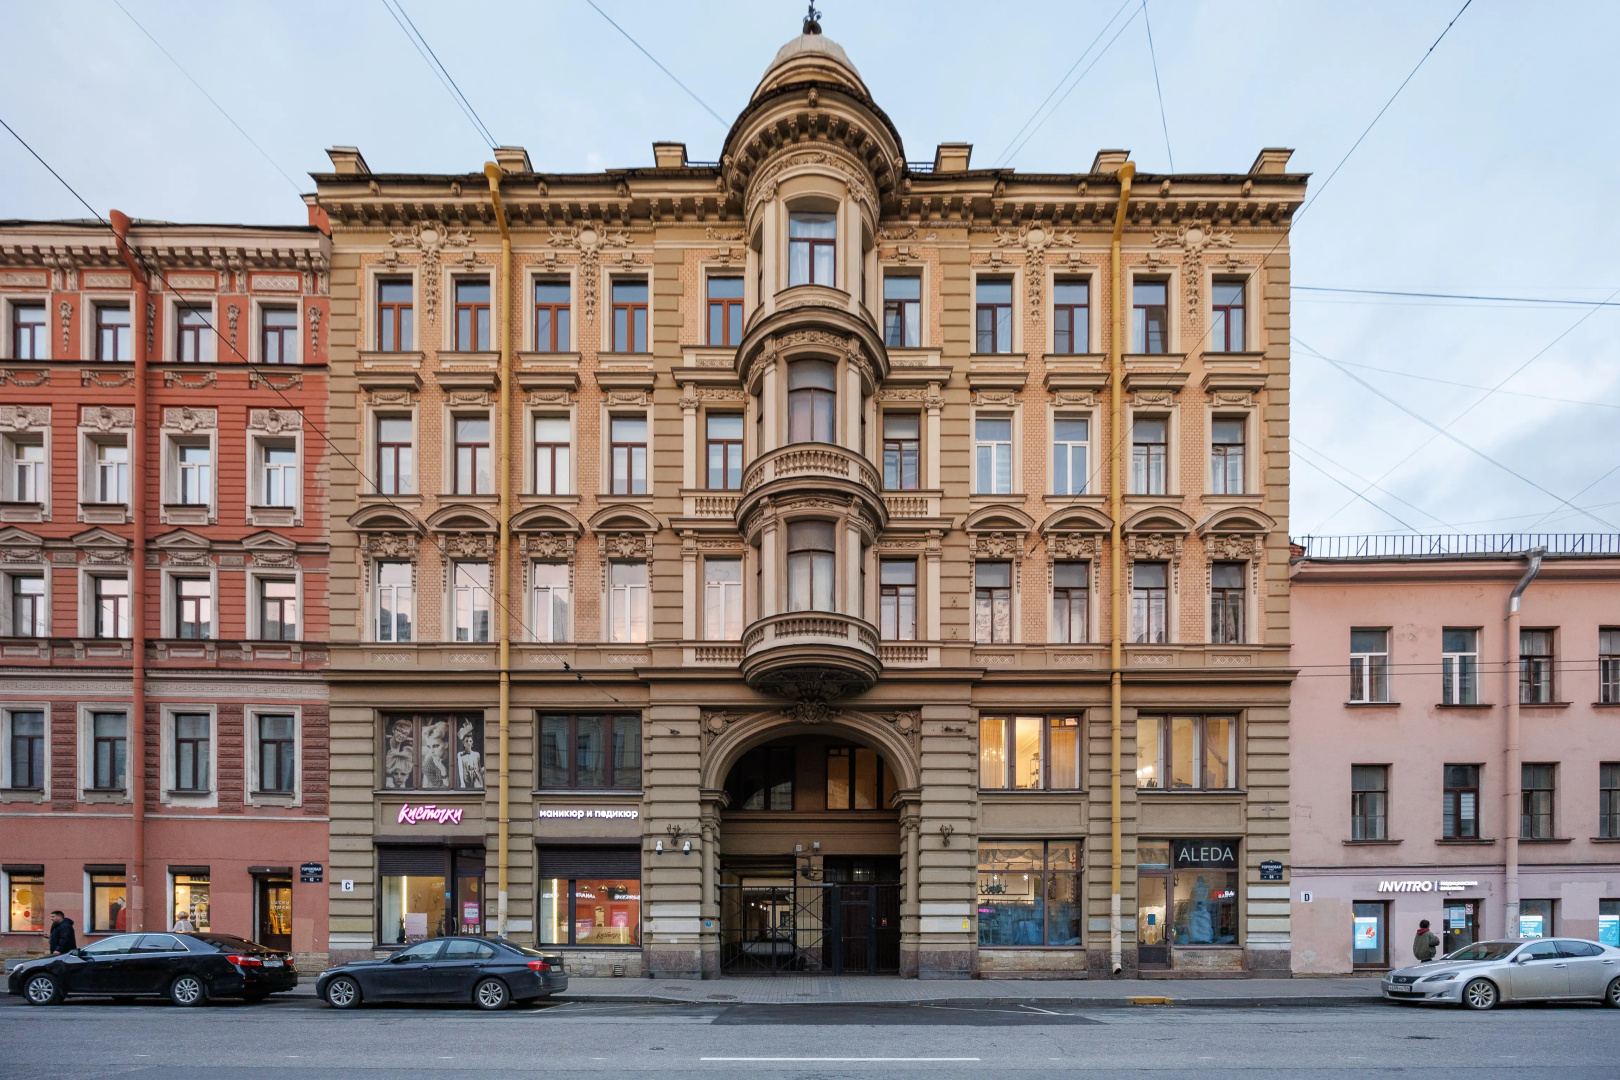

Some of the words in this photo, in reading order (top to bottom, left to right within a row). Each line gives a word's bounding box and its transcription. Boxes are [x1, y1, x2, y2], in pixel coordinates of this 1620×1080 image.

[539, 809, 585, 820] маникюр
[586, 810, 593, 818] и
[594, 809, 639, 820] педикюр
[1178, 847, 1234, 862] ALEDA
[1378, 880, 1433, 892] INVITRO
[1304, 893, 1310, 902] D
